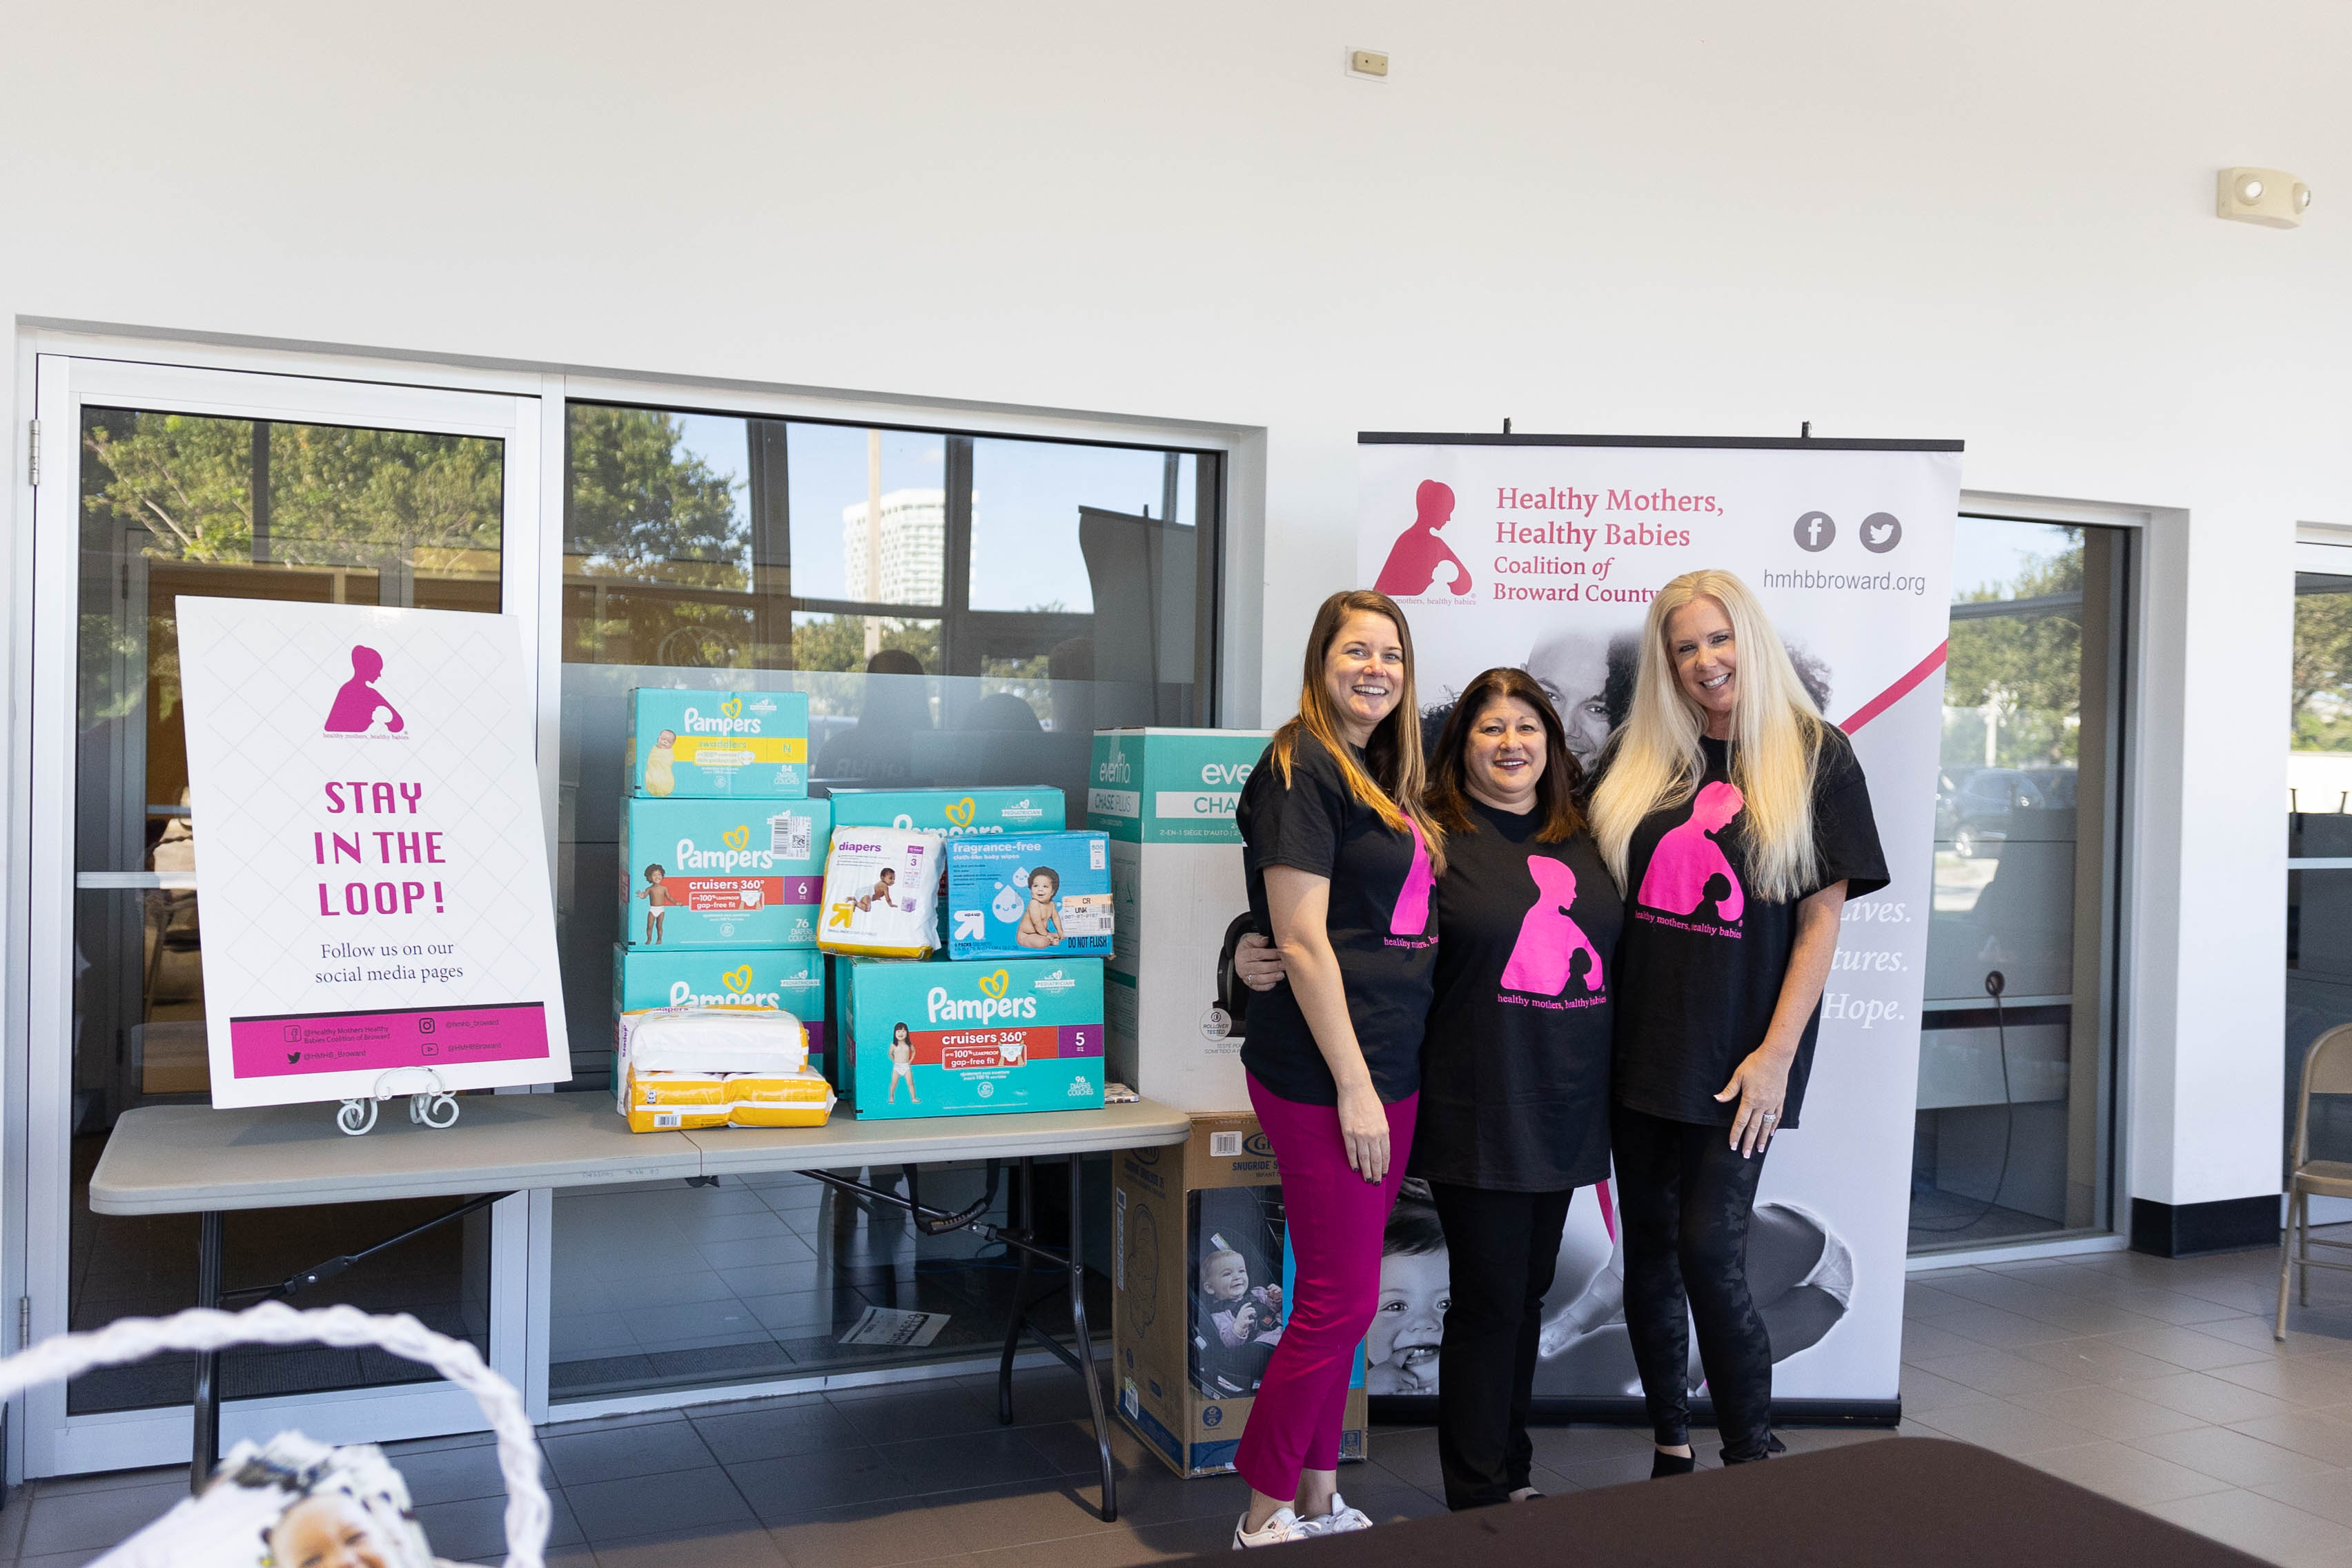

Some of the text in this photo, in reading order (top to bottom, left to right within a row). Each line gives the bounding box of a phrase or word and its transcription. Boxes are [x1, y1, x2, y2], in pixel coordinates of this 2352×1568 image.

[1496, 487, 1724, 518] Healthy Mothers,
[1495, 521, 1690, 553] Healthy Babies
[1493, 556, 1615, 581] Coalition of
[1493, 582, 1579, 601] Broward
[1764, 569, 1925, 596] hmhbbroward.org
[1427, 598, 1452, 606] healthy
[684, 707, 761, 736] Pampers
[1099, 751, 1131, 783] evenflo
[324, 781, 422, 814] STAY
[1095, 793, 1131, 812] CHASE PLUS
[1194, 797, 1237, 813] CHA
[314, 832, 446, 865] IN THE
[676, 839, 773, 873] Pampers
[839, 841, 881, 853] diapers
[953, 841, 1041, 854] fragrance-free
[689, 879, 738, 890] cruisers
[798, 882, 807, 894] 6
[319, 881, 445, 917] LOOP!
[796, 919, 809, 928] 76
[1657, 916, 1690, 931] mothers,
[1719, 926, 1742, 939] babies
[320, 943, 453, 960] Follow us on our
[1068, 936, 1107, 948] DO NOT FLUSH
[1384, 937, 1410, 949] healthy
[1831, 946, 1908, 972] tures.
[315, 963, 464, 984] social media pages
[927, 987, 1037, 1025] Pampers
[1498, 994, 1529, 1007] healthy
[1532, 999, 1564, 1010] mothers,
[1565, 998, 1589, 1009] healthy
[1821, 993, 1905, 1029] Hope.
[304, 1028, 335, 1037] @Healthy
[942, 1032, 997, 1045] cruisers
[1075, 1032, 1085, 1046] 5
[951, 1058, 985, 1068] gap-free
[1233, 1161, 1270, 1171] SNUGRIDE
